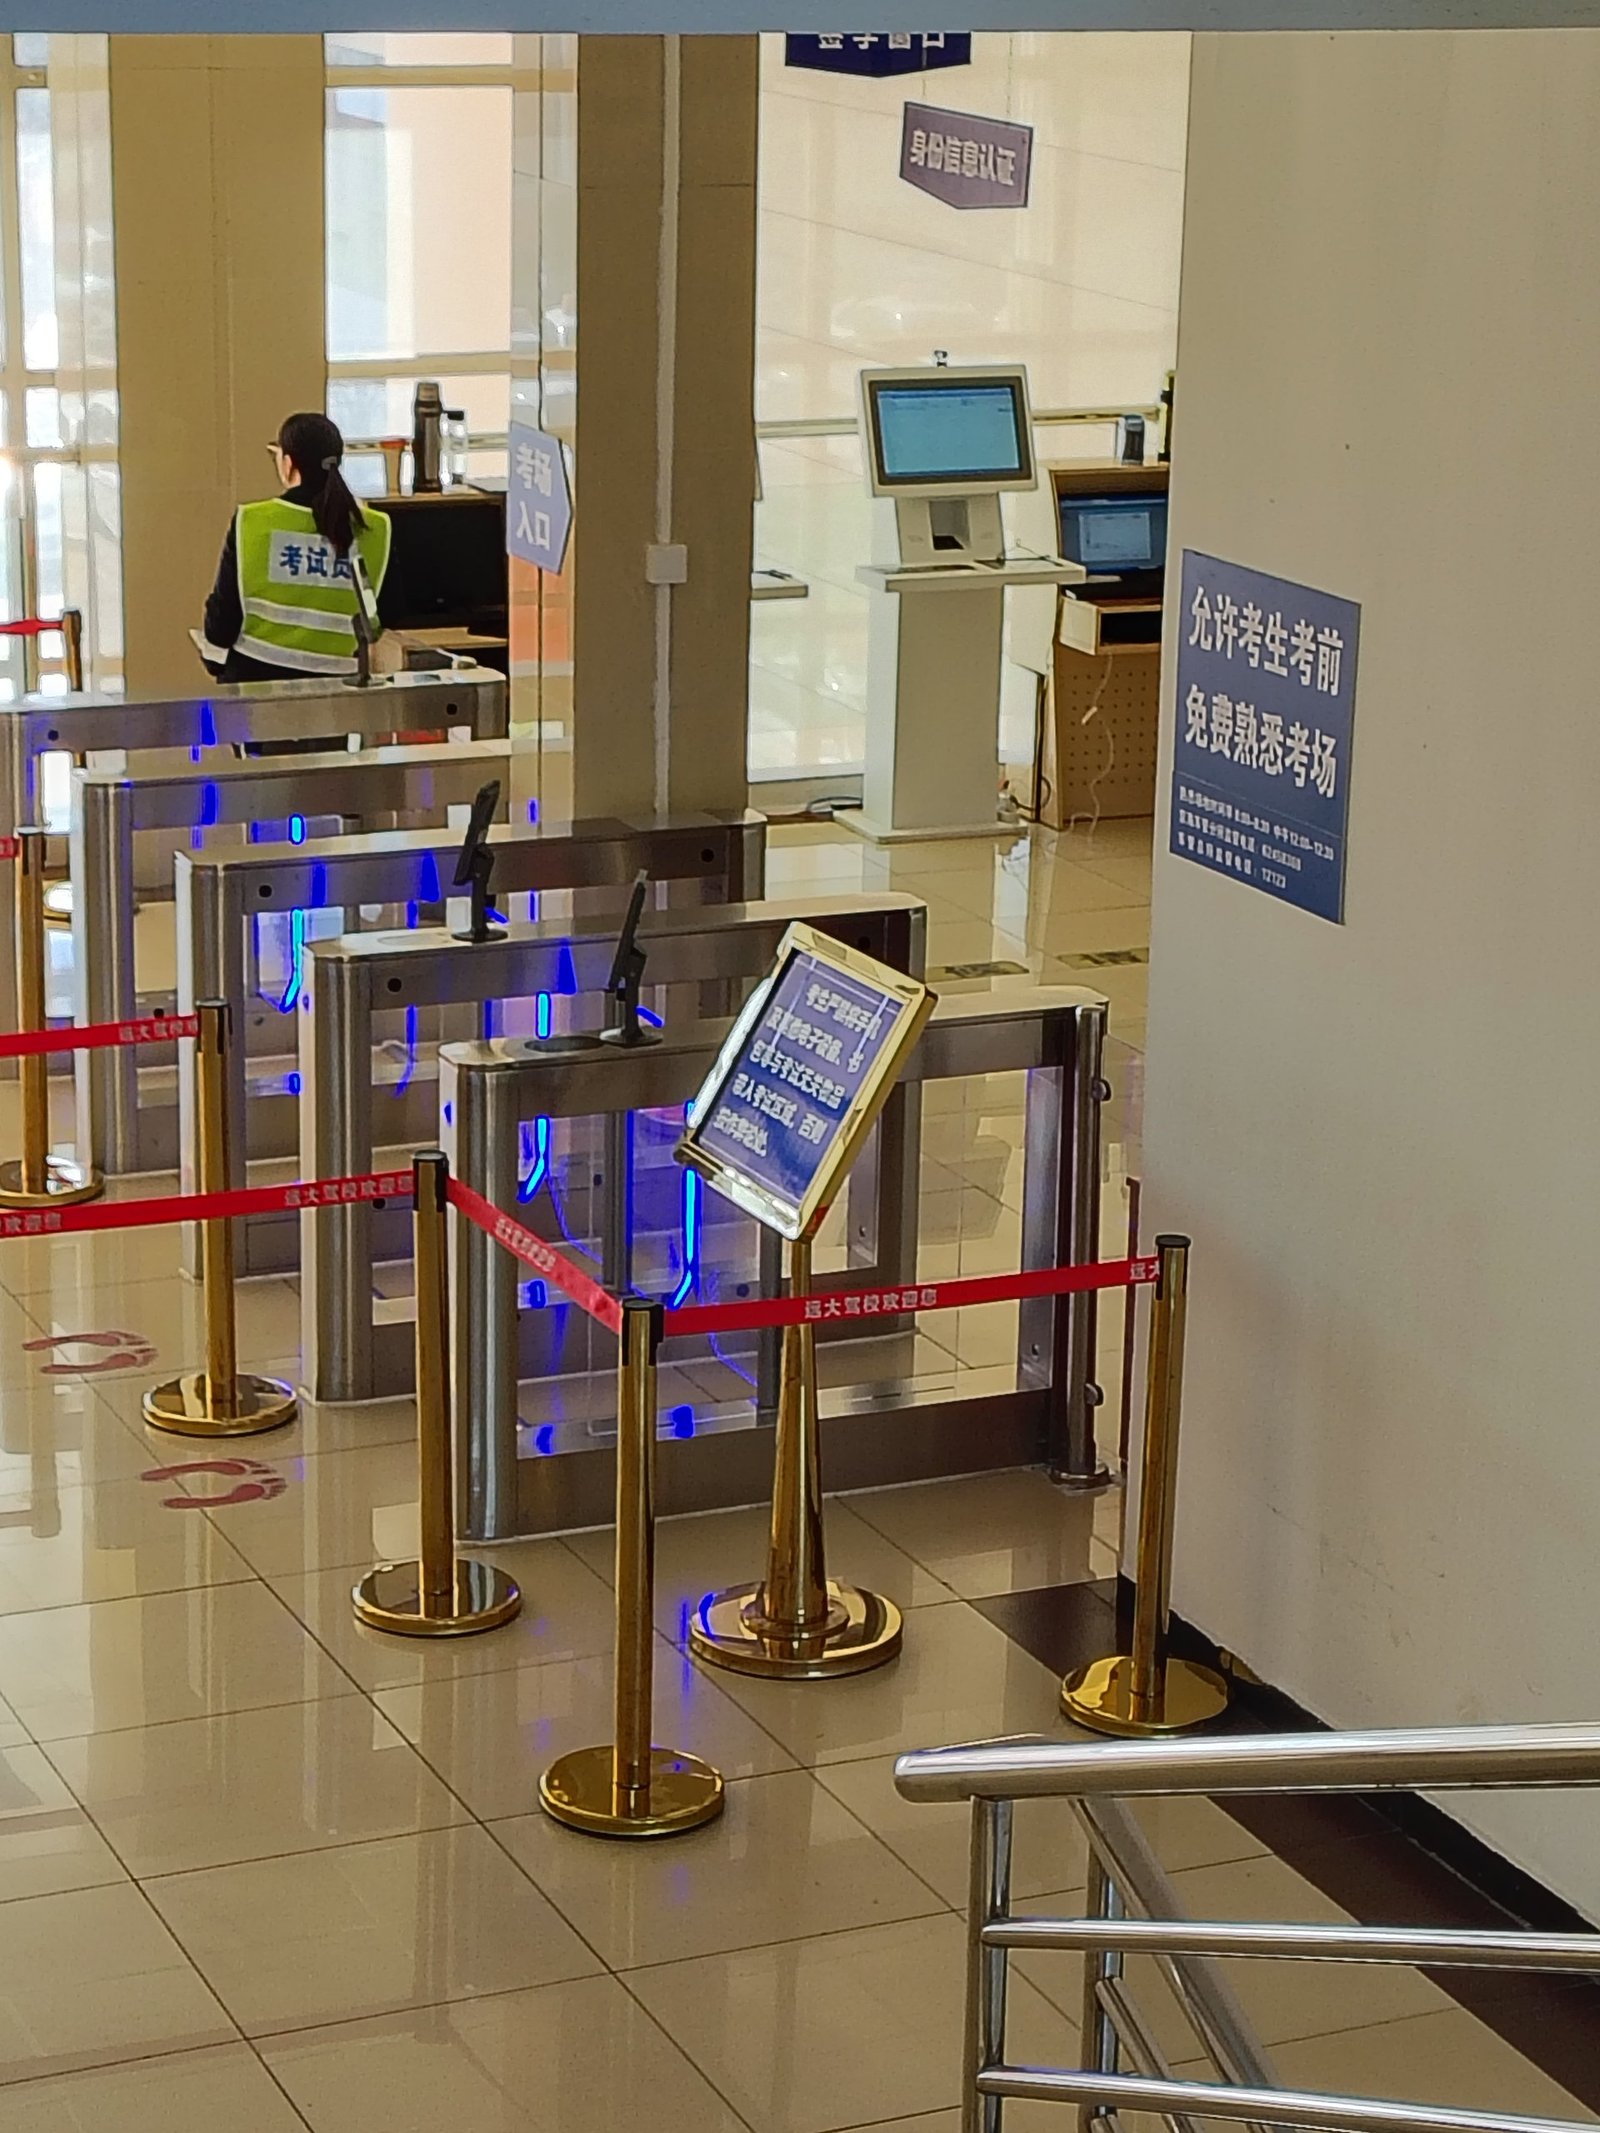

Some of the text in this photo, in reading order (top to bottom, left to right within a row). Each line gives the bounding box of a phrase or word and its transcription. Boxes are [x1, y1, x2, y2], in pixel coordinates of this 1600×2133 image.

[909, 128, 1017, 187] 身份信息认证
[515, 500, 551, 551] 入口
[279, 544, 352, 579] 考试员
[1188, 585, 1344, 696] 允许考生考前
[1184, 683, 1337, 799] 免费熟悉考场
[803, 1288, 938, 1319] 远大驾校欢迎您
